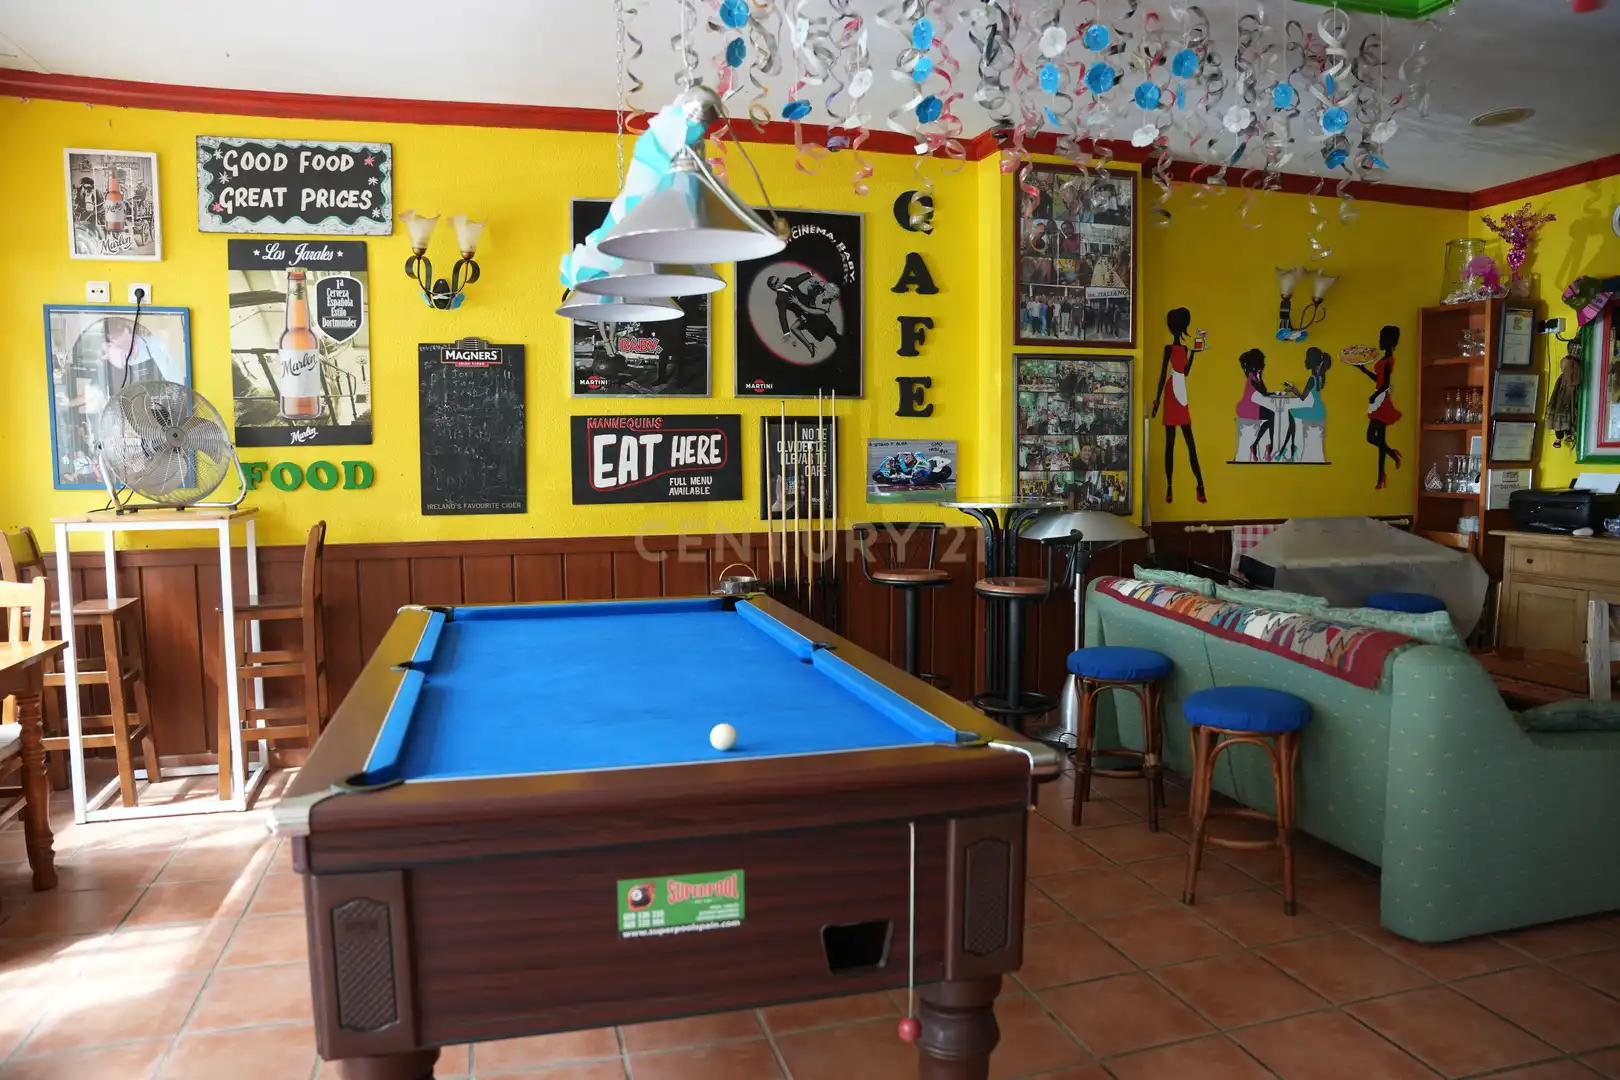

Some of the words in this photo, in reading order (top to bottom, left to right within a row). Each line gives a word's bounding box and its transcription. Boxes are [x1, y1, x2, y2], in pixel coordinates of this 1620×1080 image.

[223, 149, 288, 177] GOOD
[299, 151, 354, 173] FOOD
[219, 187, 288, 214] GREAT
[301, 188, 373, 212] PRICES
[262, 242, 286, 260] Los
[288, 243, 333, 266] Jarales
[326, 288, 349, 299] Cerveza
[327, 298, 353, 307] Española
[331, 307, 347, 316] Estilo
[322, 317, 357, 328] Dortmunder
[445, 350, 498, 361] MAGNERS
[281, 352, 318, 378] Marlen
[587, 417, 663, 430] MANNEQUINS
[290, 426, 318, 445] Marlen
[801, 428, 814, 440] NO
[776, 440, 814, 453] OVDE
[593, 434, 663, 488] EAT
[671, 434, 722, 467] HERE
[780, 453, 814, 465] LEVAR
[239, 460, 375, 492] FOOD
[669, 477, 687, 486] FULL
[690, 476, 713, 485] MENU
[669, 487, 711, 496] AVAILABLE
[667, 873, 740, 905] SUPERPOOL
